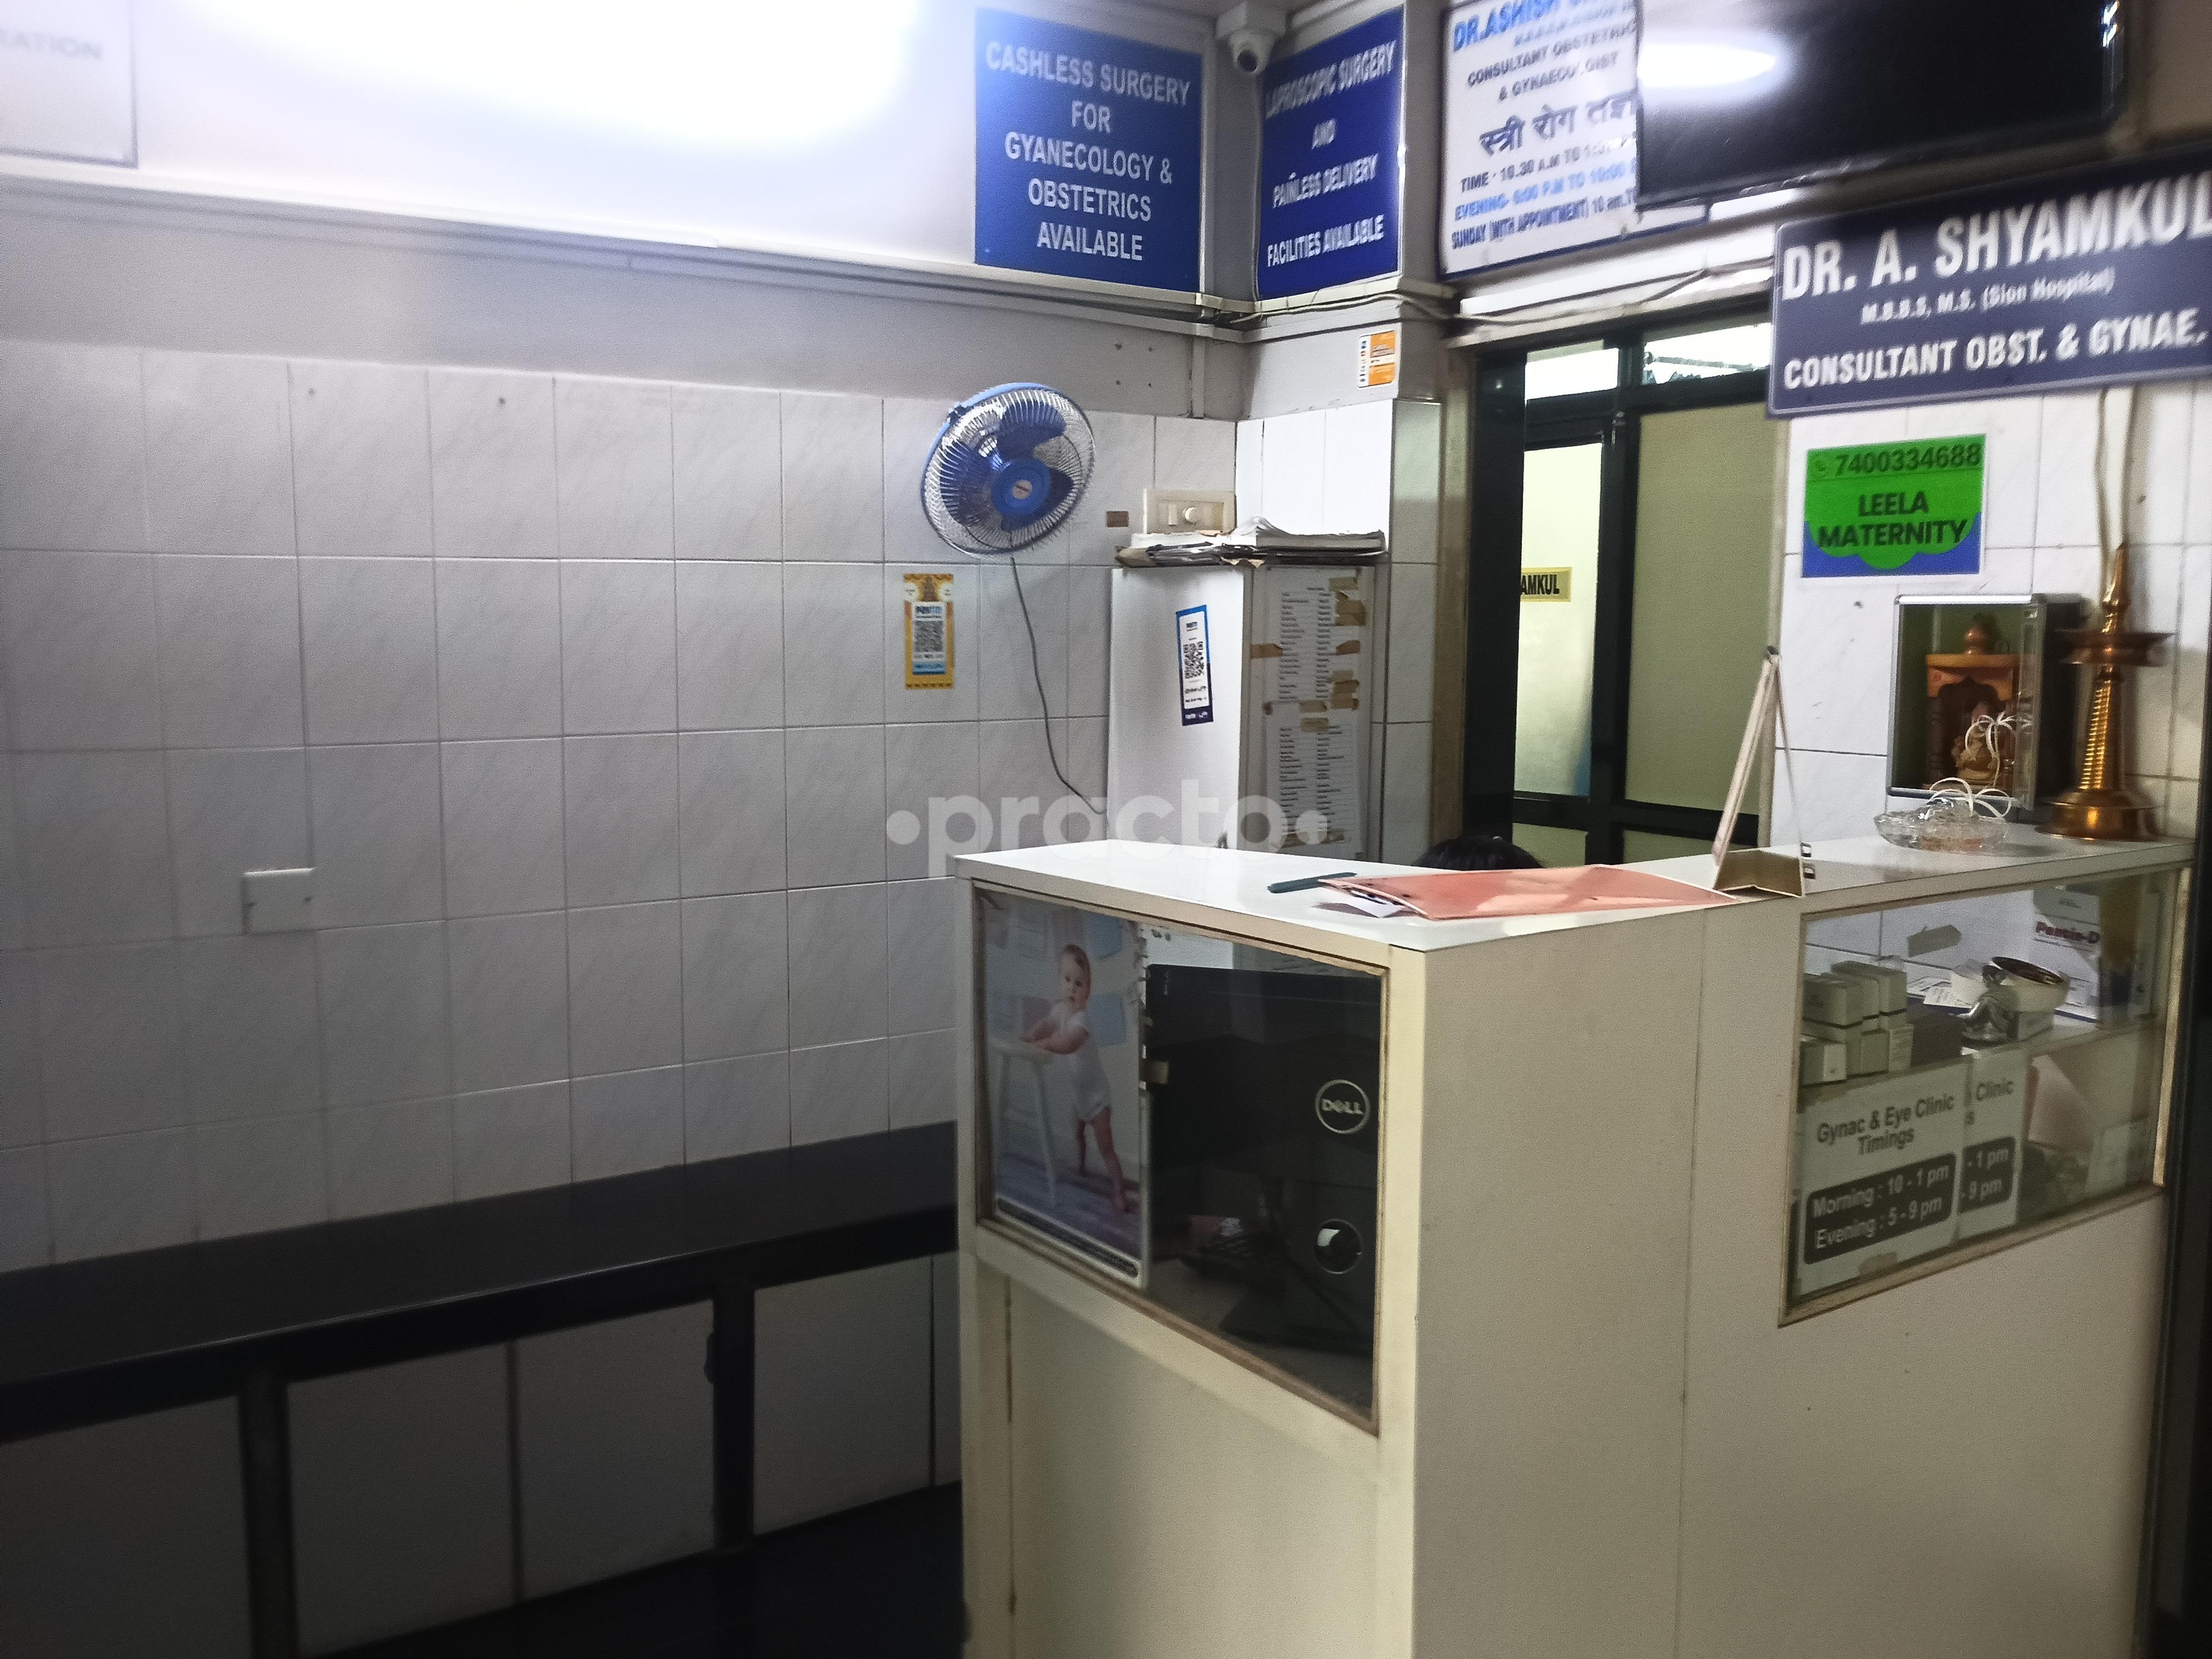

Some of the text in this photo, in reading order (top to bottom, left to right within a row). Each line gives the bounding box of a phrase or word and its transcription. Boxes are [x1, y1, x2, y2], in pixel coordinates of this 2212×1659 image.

[0, 29, 104, 60] ATION
[986, 41, 1190, 106] CASHLESS SURGERY
[1338, 40, 1397, 93] SURGERY
[1467, 44, 1549, 87] CONSULTANT
[1498, 86, 1508, 102] &
[1071, 100, 1111, 133] FOR
[1480, 115, 1525, 158] स्त्री
[1532, 104, 1579, 140] रोग
[1005, 131, 1173, 184] GYANECOLOGY &
[1273, 153, 1379, 208] PAINLESS DELIVERY
[1460, 171, 1489, 193] TIME
[1029, 178, 1152, 222] OBSTETRICS
[1036, 221, 1143, 261] AVAILABLE
[1267, 214, 1384, 267] FACILITIES AVAILABLE
[1452, 223, 1487, 250] SUNDAY
[1782, 169, 2212, 301] DR. A. SHYAMKUL
[2030, 266, 2116, 302] Hospital)
[1784, 307, 2208, 390] CONSULTANT OBST. & GYNAE.
[1835, 443, 1982, 478] 7400334688
[1858, 490, 1930, 517] LEELA
[1817, 518, 1968, 549] MATERNITY
[1521, 574, 1560, 595] AMKUL
[1322, 1098, 1363, 1115] DELL
[1975, 1079, 2015, 1102] Clinic
[1816, 1118, 1865, 1146] Gynac
[1868, 1110, 1880, 1130] &
[1883, 1105, 1912, 1129] Eye
[1915, 1092, 1955, 1119] Clinic
[1858, 1127, 1915, 1155] Timings
[1987, 1148, 2010, 1170] pm
[1813, 1187, 1875, 1219] Morning
[1926, 1165, 1950, 1188] pm
[1979, 1178, 2003, 1202] pm
[1815, 1218, 1876, 1250] Evening
[1920, 1197, 1943, 1221] pm
